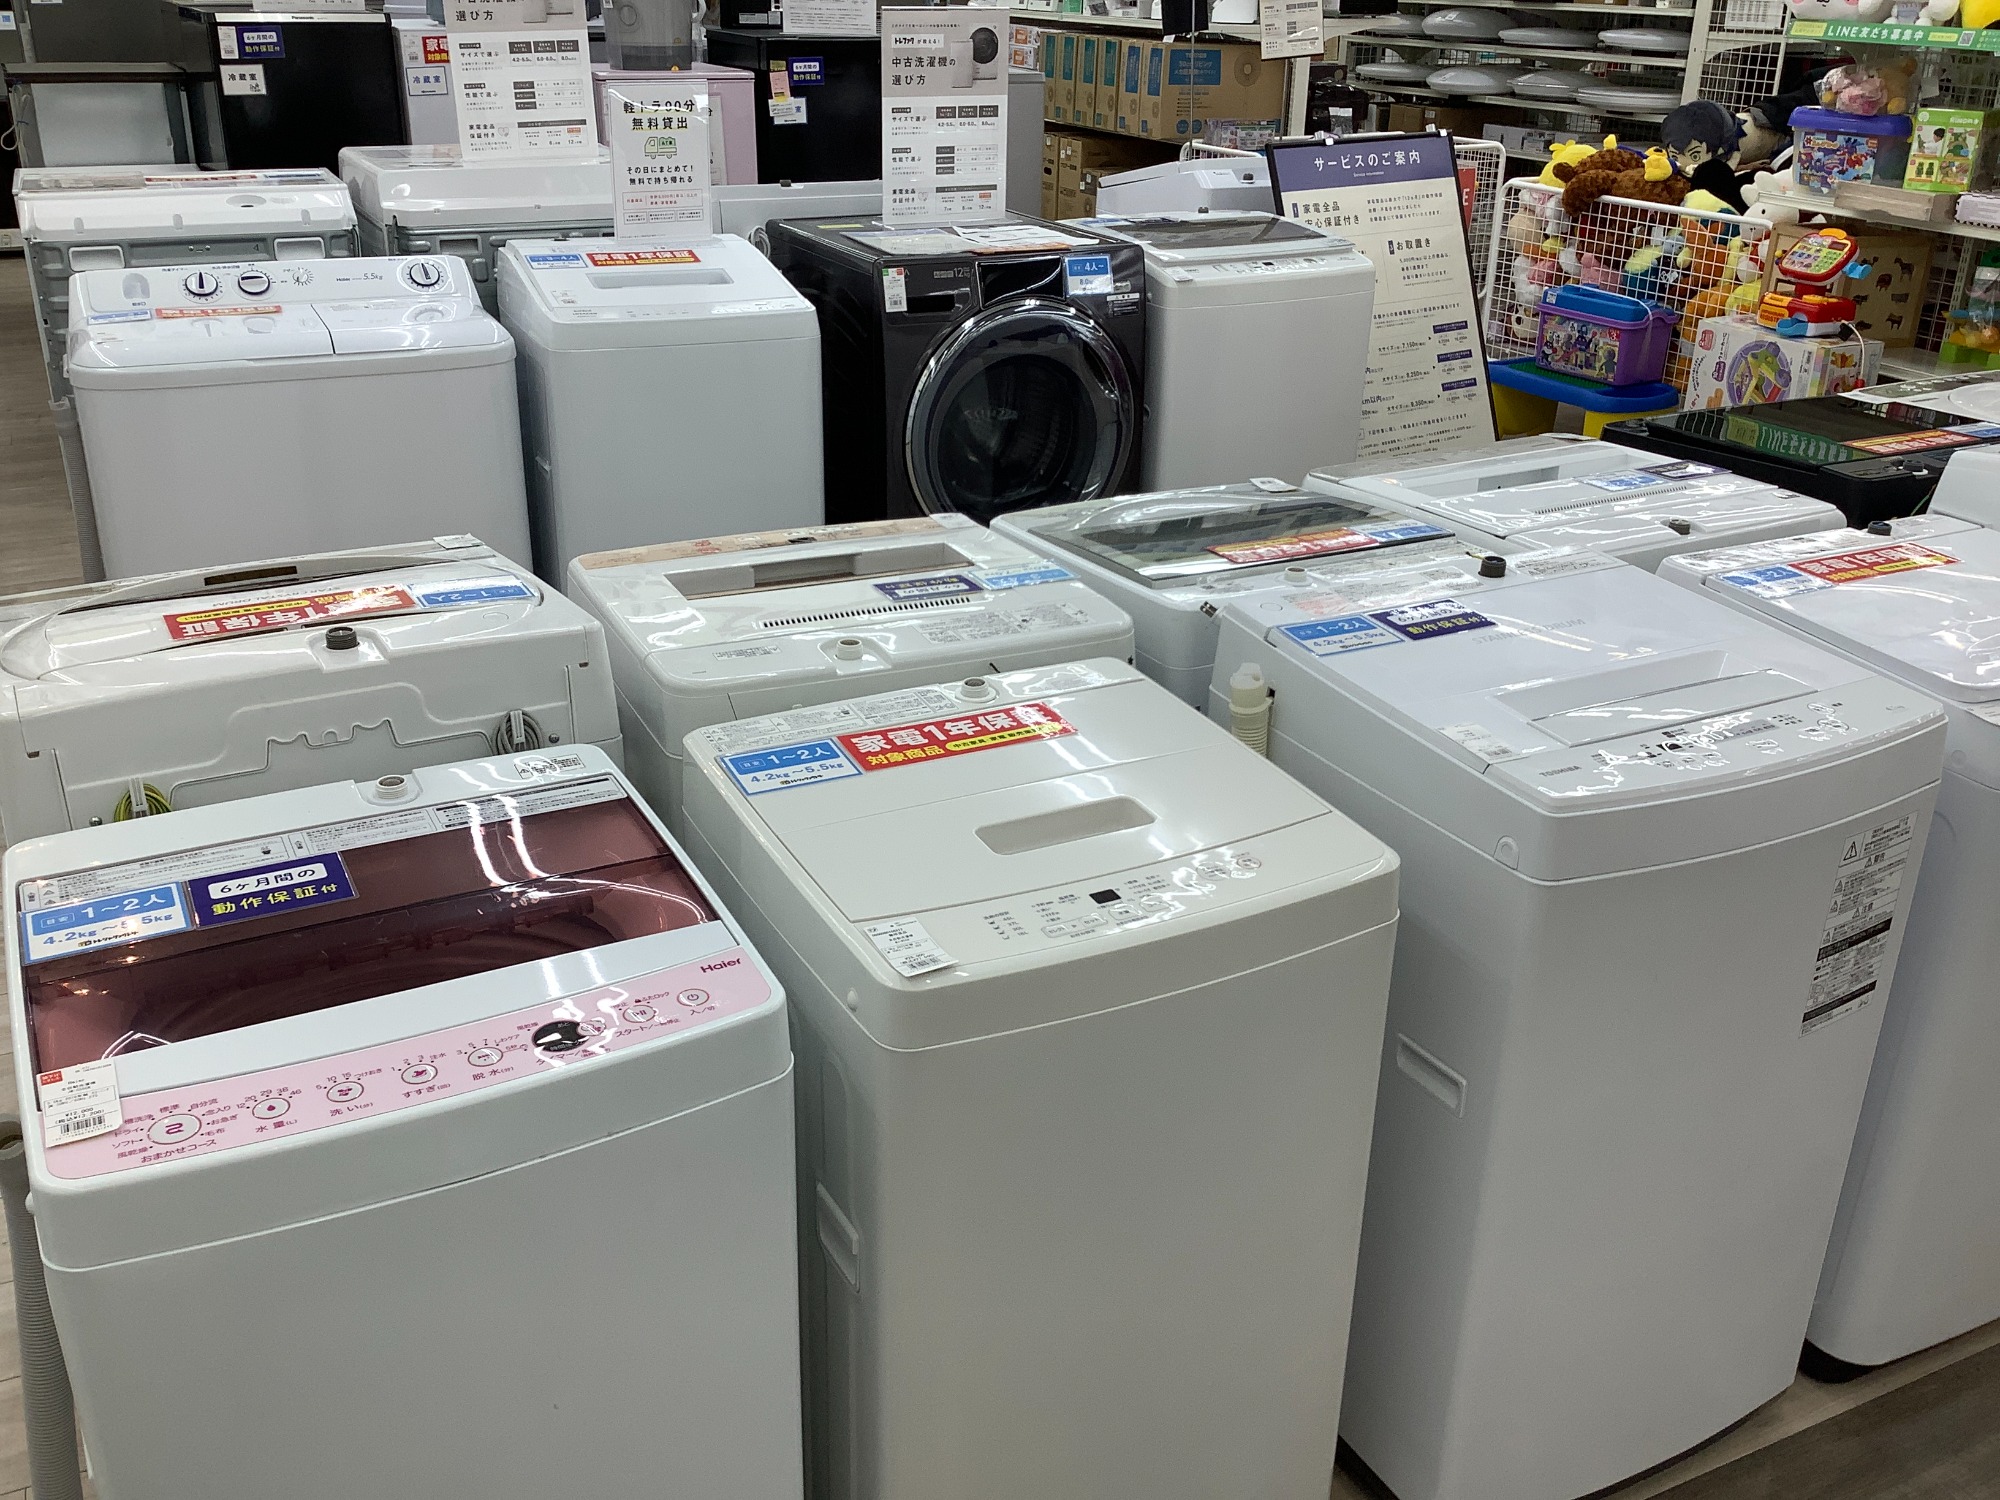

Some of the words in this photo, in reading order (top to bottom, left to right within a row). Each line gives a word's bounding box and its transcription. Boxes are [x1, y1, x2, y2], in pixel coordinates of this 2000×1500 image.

[455, 9, 494, 22] 選び方
[1827, 25, 1924, 42] LINE友だち募集中
[891, 55, 956, 68] 中古洗濯機の
[228, 73, 258, 82] 冷蔵室
[412, 75, 441, 84] 冷蔵室
[891, 74, 926, 86] 選び方
[631, 116, 689, 131] 無料貸出
[1313, 149, 1422, 172] サービスのご案内
[629, 175, 693, 186] 無料で持ち帰れる
[1462, 187, 1470, 206] E
[1302, 200, 1341, 215] 家電全品
[1304, 213, 1360, 229] 安心保証付き
[1396, 237, 1431, 251] お取置き
[593, 250, 692, 262] 家電1年保証
[1316, 619, 1367, 634] 1~2人
[1405, 615, 1480, 635] 動作保証付
[1543, 617, 1587, 631] DRUM
[767, 747, 831, 765] 1~2人
[866, 745, 945, 766] 対象商品
[750, 762, 845, 783] 4.2kg~5.5kg
[1538, 765, 1583, 777] TOSHIBA
[219, 866, 316, 895] 6ヶ月間の
[79, 892, 167, 920] 1~2人
[210, 882, 339, 917] 動作保証付
[699, 956, 742, 974] Haier
[244, 1095, 257, 1103] 20
[260, 1088, 273, 1096] 29
[289, 1088, 303, 1097] 46
[159, 1103, 180, 1113] 標準
[190, 1098, 219, 1110] 自分流
[210, 1113, 239, 1125] お急ぎ
[255, 1118, 298, 1133] 水量(L)
[114, 1127, 140, 1137] ドライ
[205, 1127, 225, 1137] 毛布
[112, 1138, 139, 1149] ソフト
[140, 1138, 217, 1163] おまかせコース
